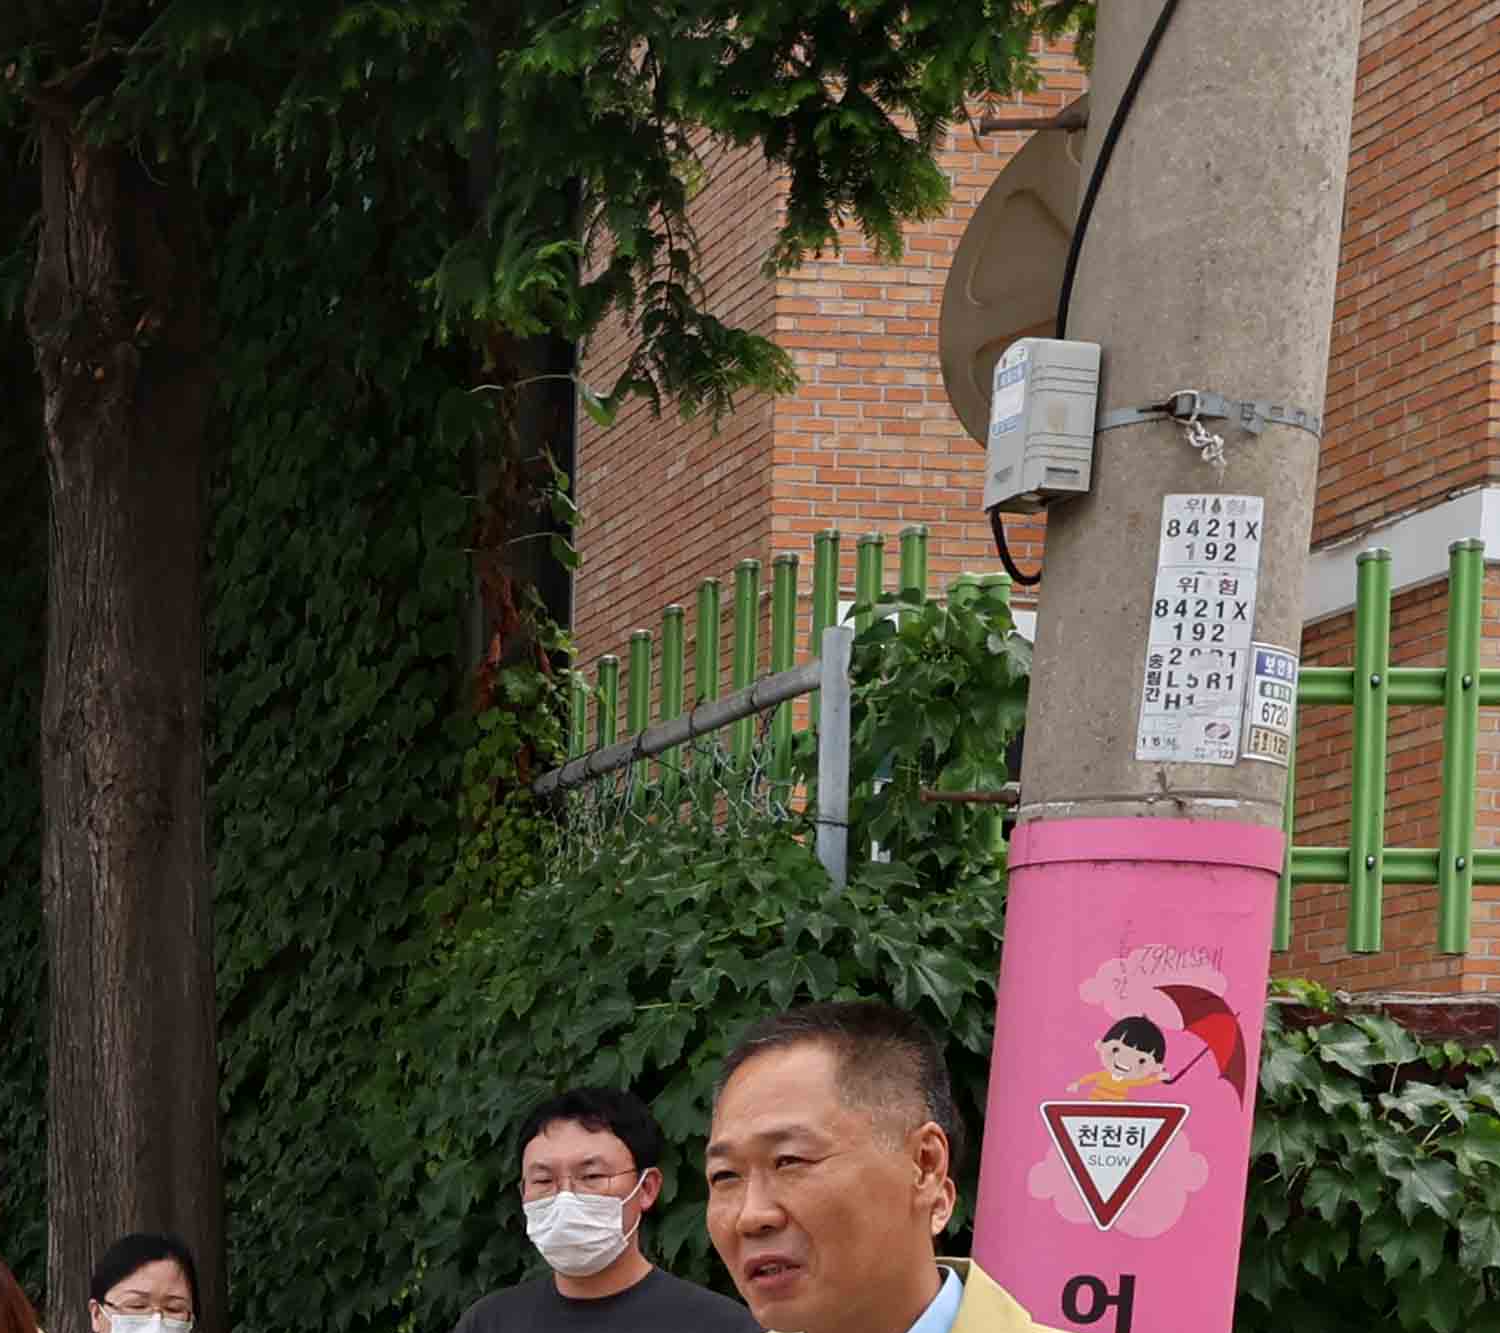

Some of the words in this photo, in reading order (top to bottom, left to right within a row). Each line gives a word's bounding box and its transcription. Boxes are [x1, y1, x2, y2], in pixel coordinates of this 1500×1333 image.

[1185, 542, 1237, 562] 192
[1172, 622, 1225, 642] 192
[1077, 1124, 1147, 1149] 천천히
[1087, 1154, 1132, 1167] SLOW
